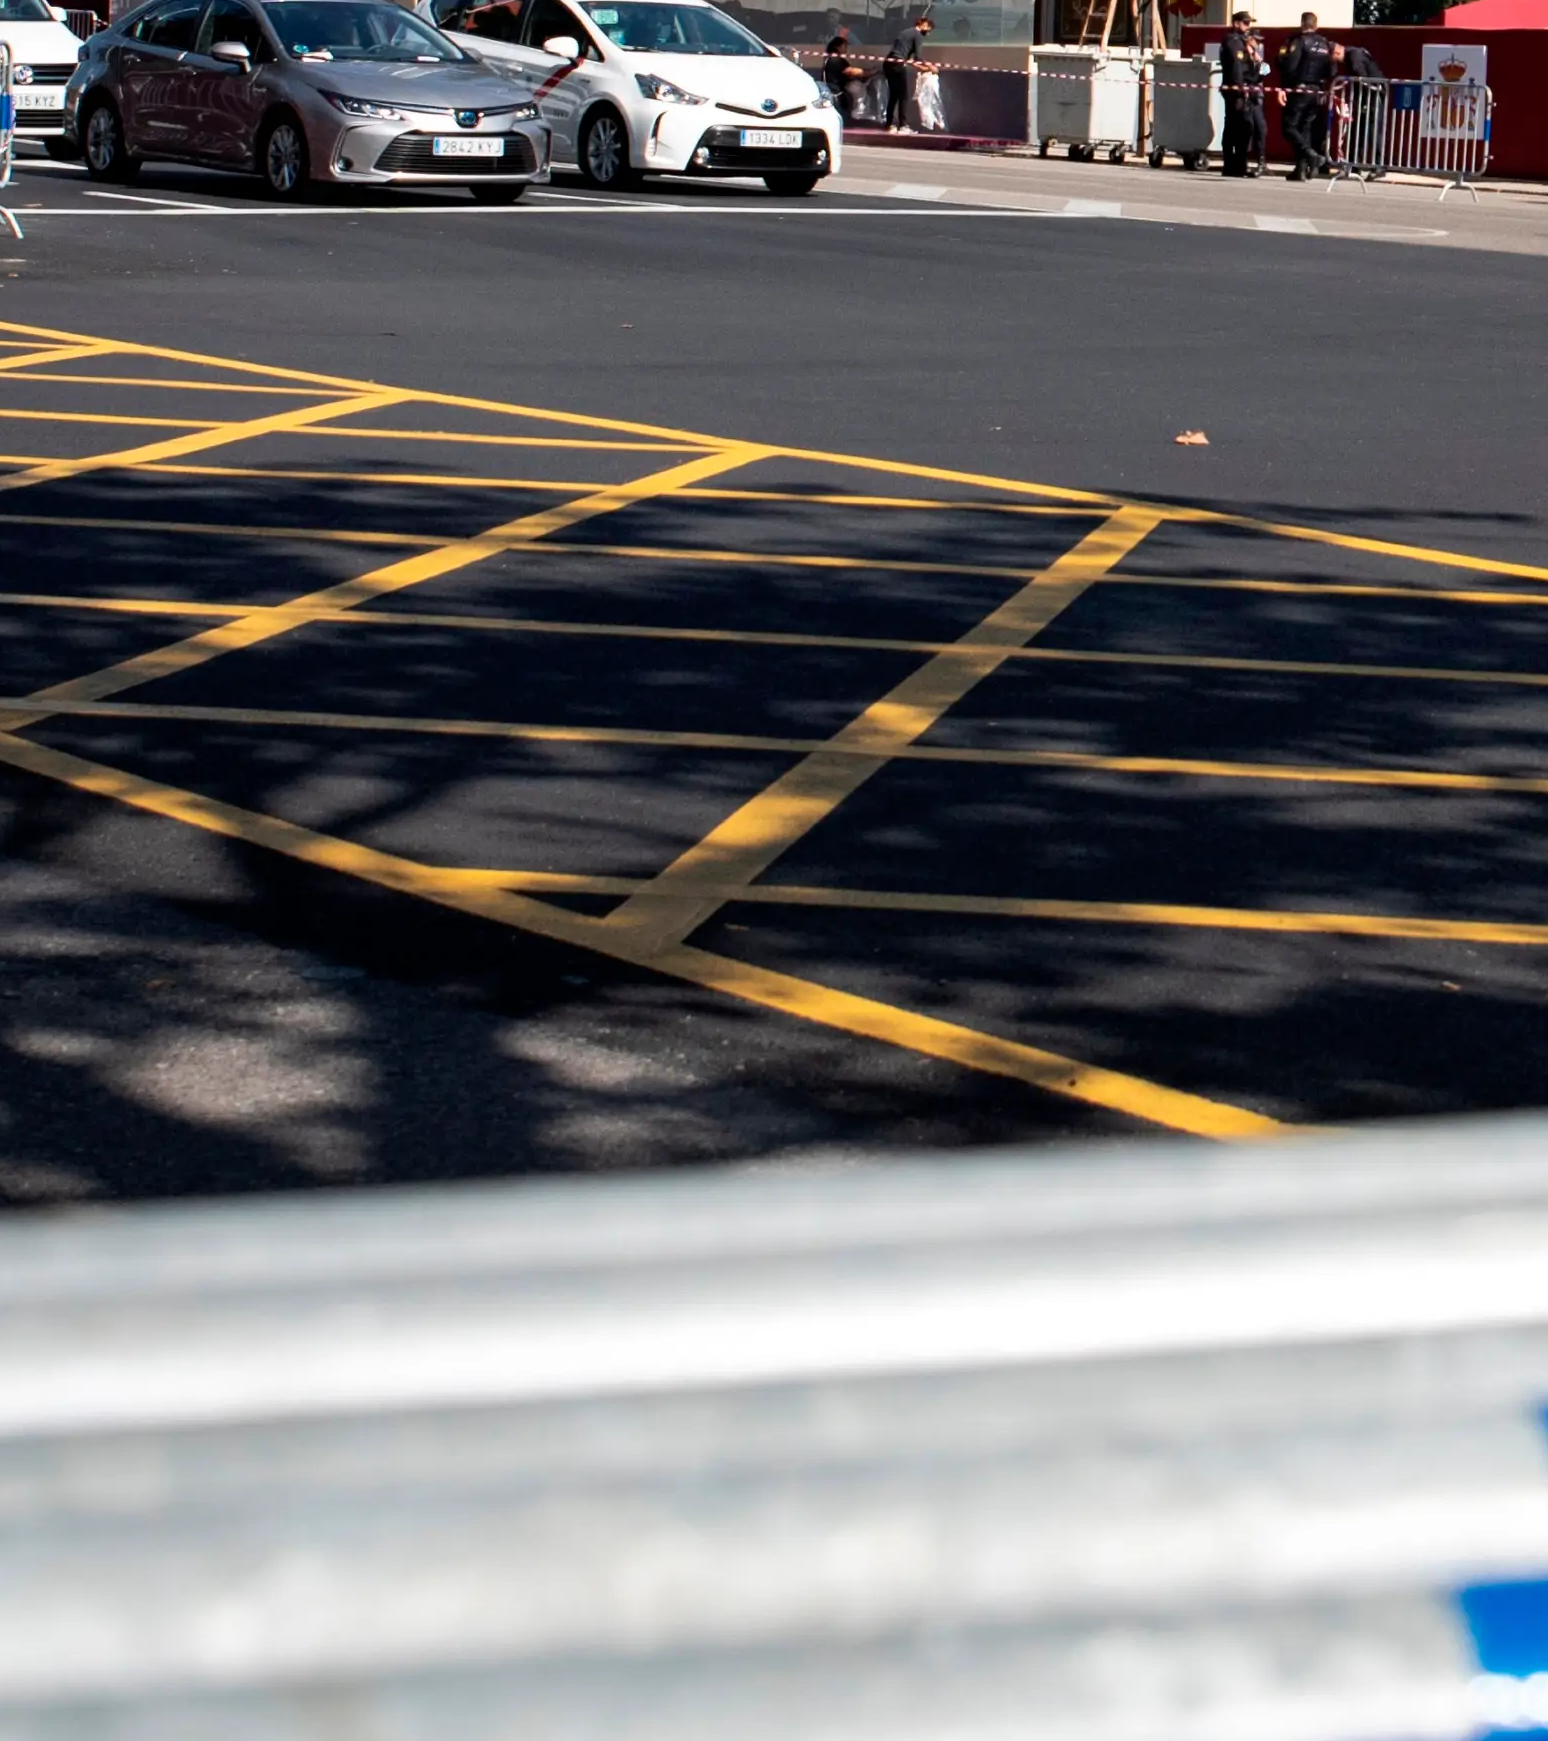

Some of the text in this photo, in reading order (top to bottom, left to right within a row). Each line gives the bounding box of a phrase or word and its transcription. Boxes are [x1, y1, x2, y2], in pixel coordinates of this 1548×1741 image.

[34, 95, 57, 108] KYZ
[749, 132, 775, 145] 1334
[442, 140, 473, 154] 2842
